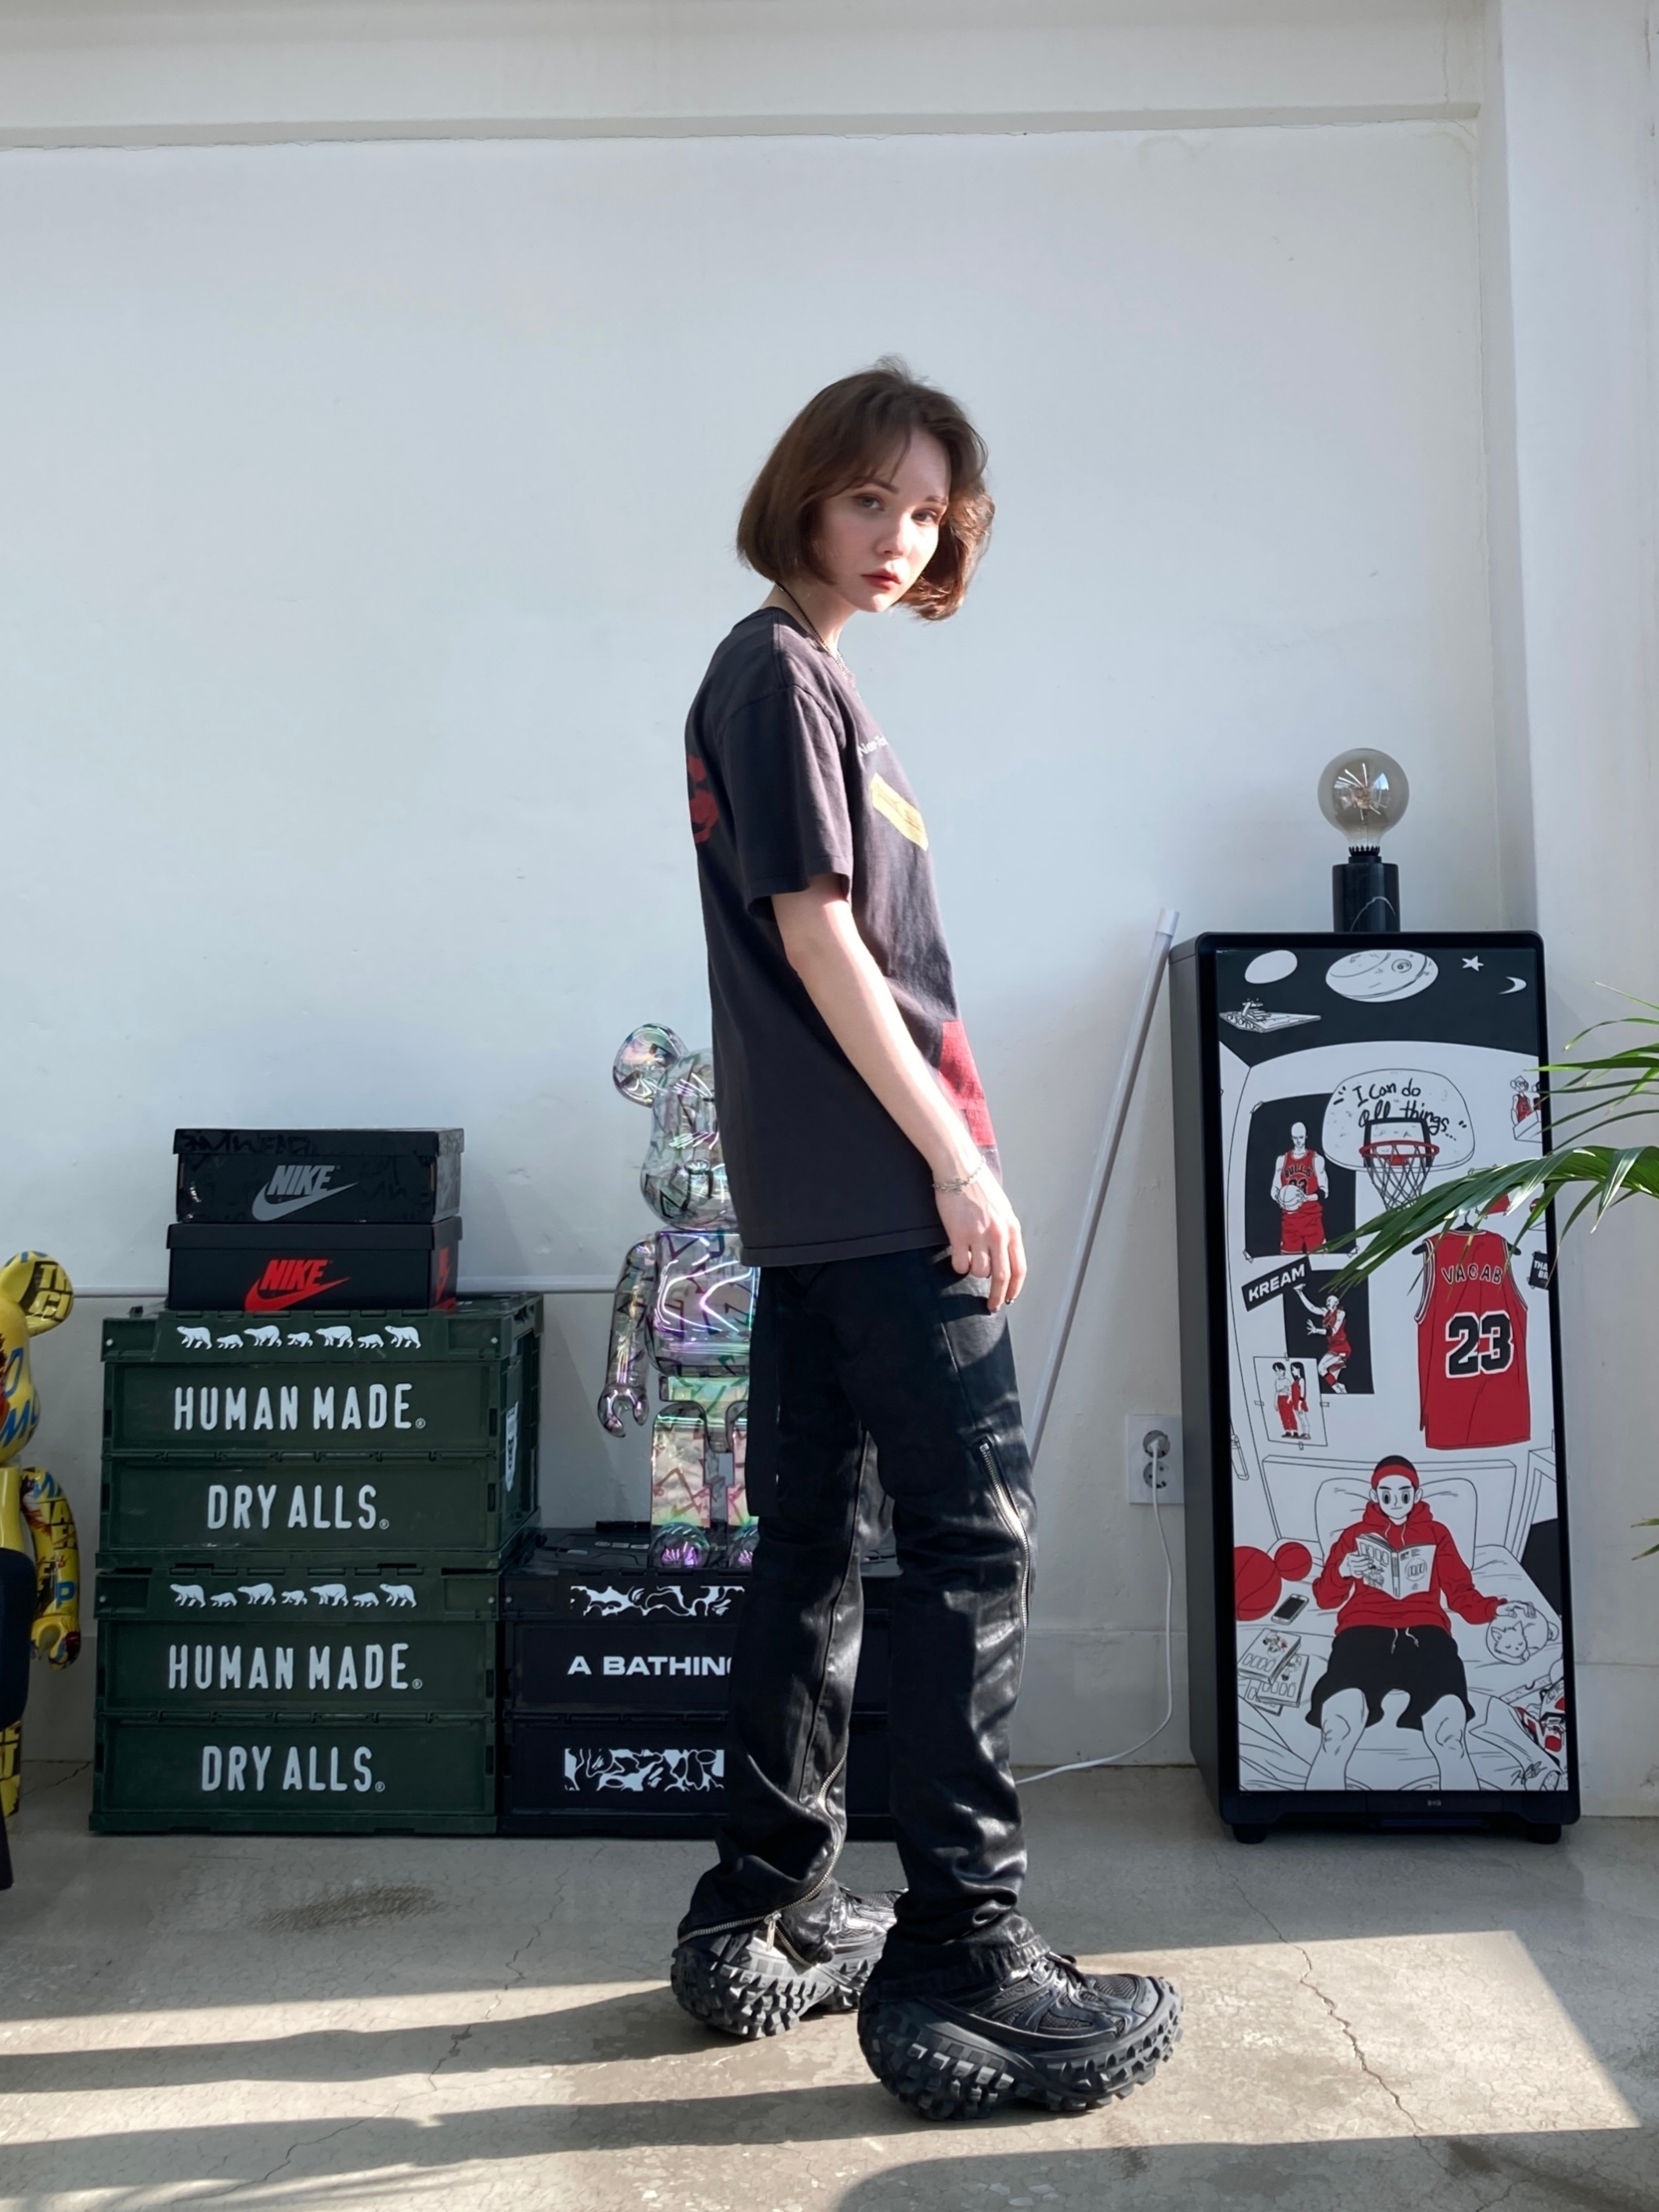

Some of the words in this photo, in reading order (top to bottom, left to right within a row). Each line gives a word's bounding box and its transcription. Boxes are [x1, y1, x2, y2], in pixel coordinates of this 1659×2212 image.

[1401, 1078, 1421, 1097] do
[266, 1165, 335, 1196] NIKE
[258, 1259, 329, 1291] NIKE
[1248, 1263, 1306, 1302] KREAM
[1445, 1310, 1515, 1378] 23
[174, 1385, 298, 1431] HUMAN
[207, 1484, 277, 1529] DRY
[168, 1645, 294, 1690] HUMAN
[567, 1655, 592, 1675] A
[603, 1655, 732, 1676] BATHIN
[201, 1745, 271, 1791] DRY
